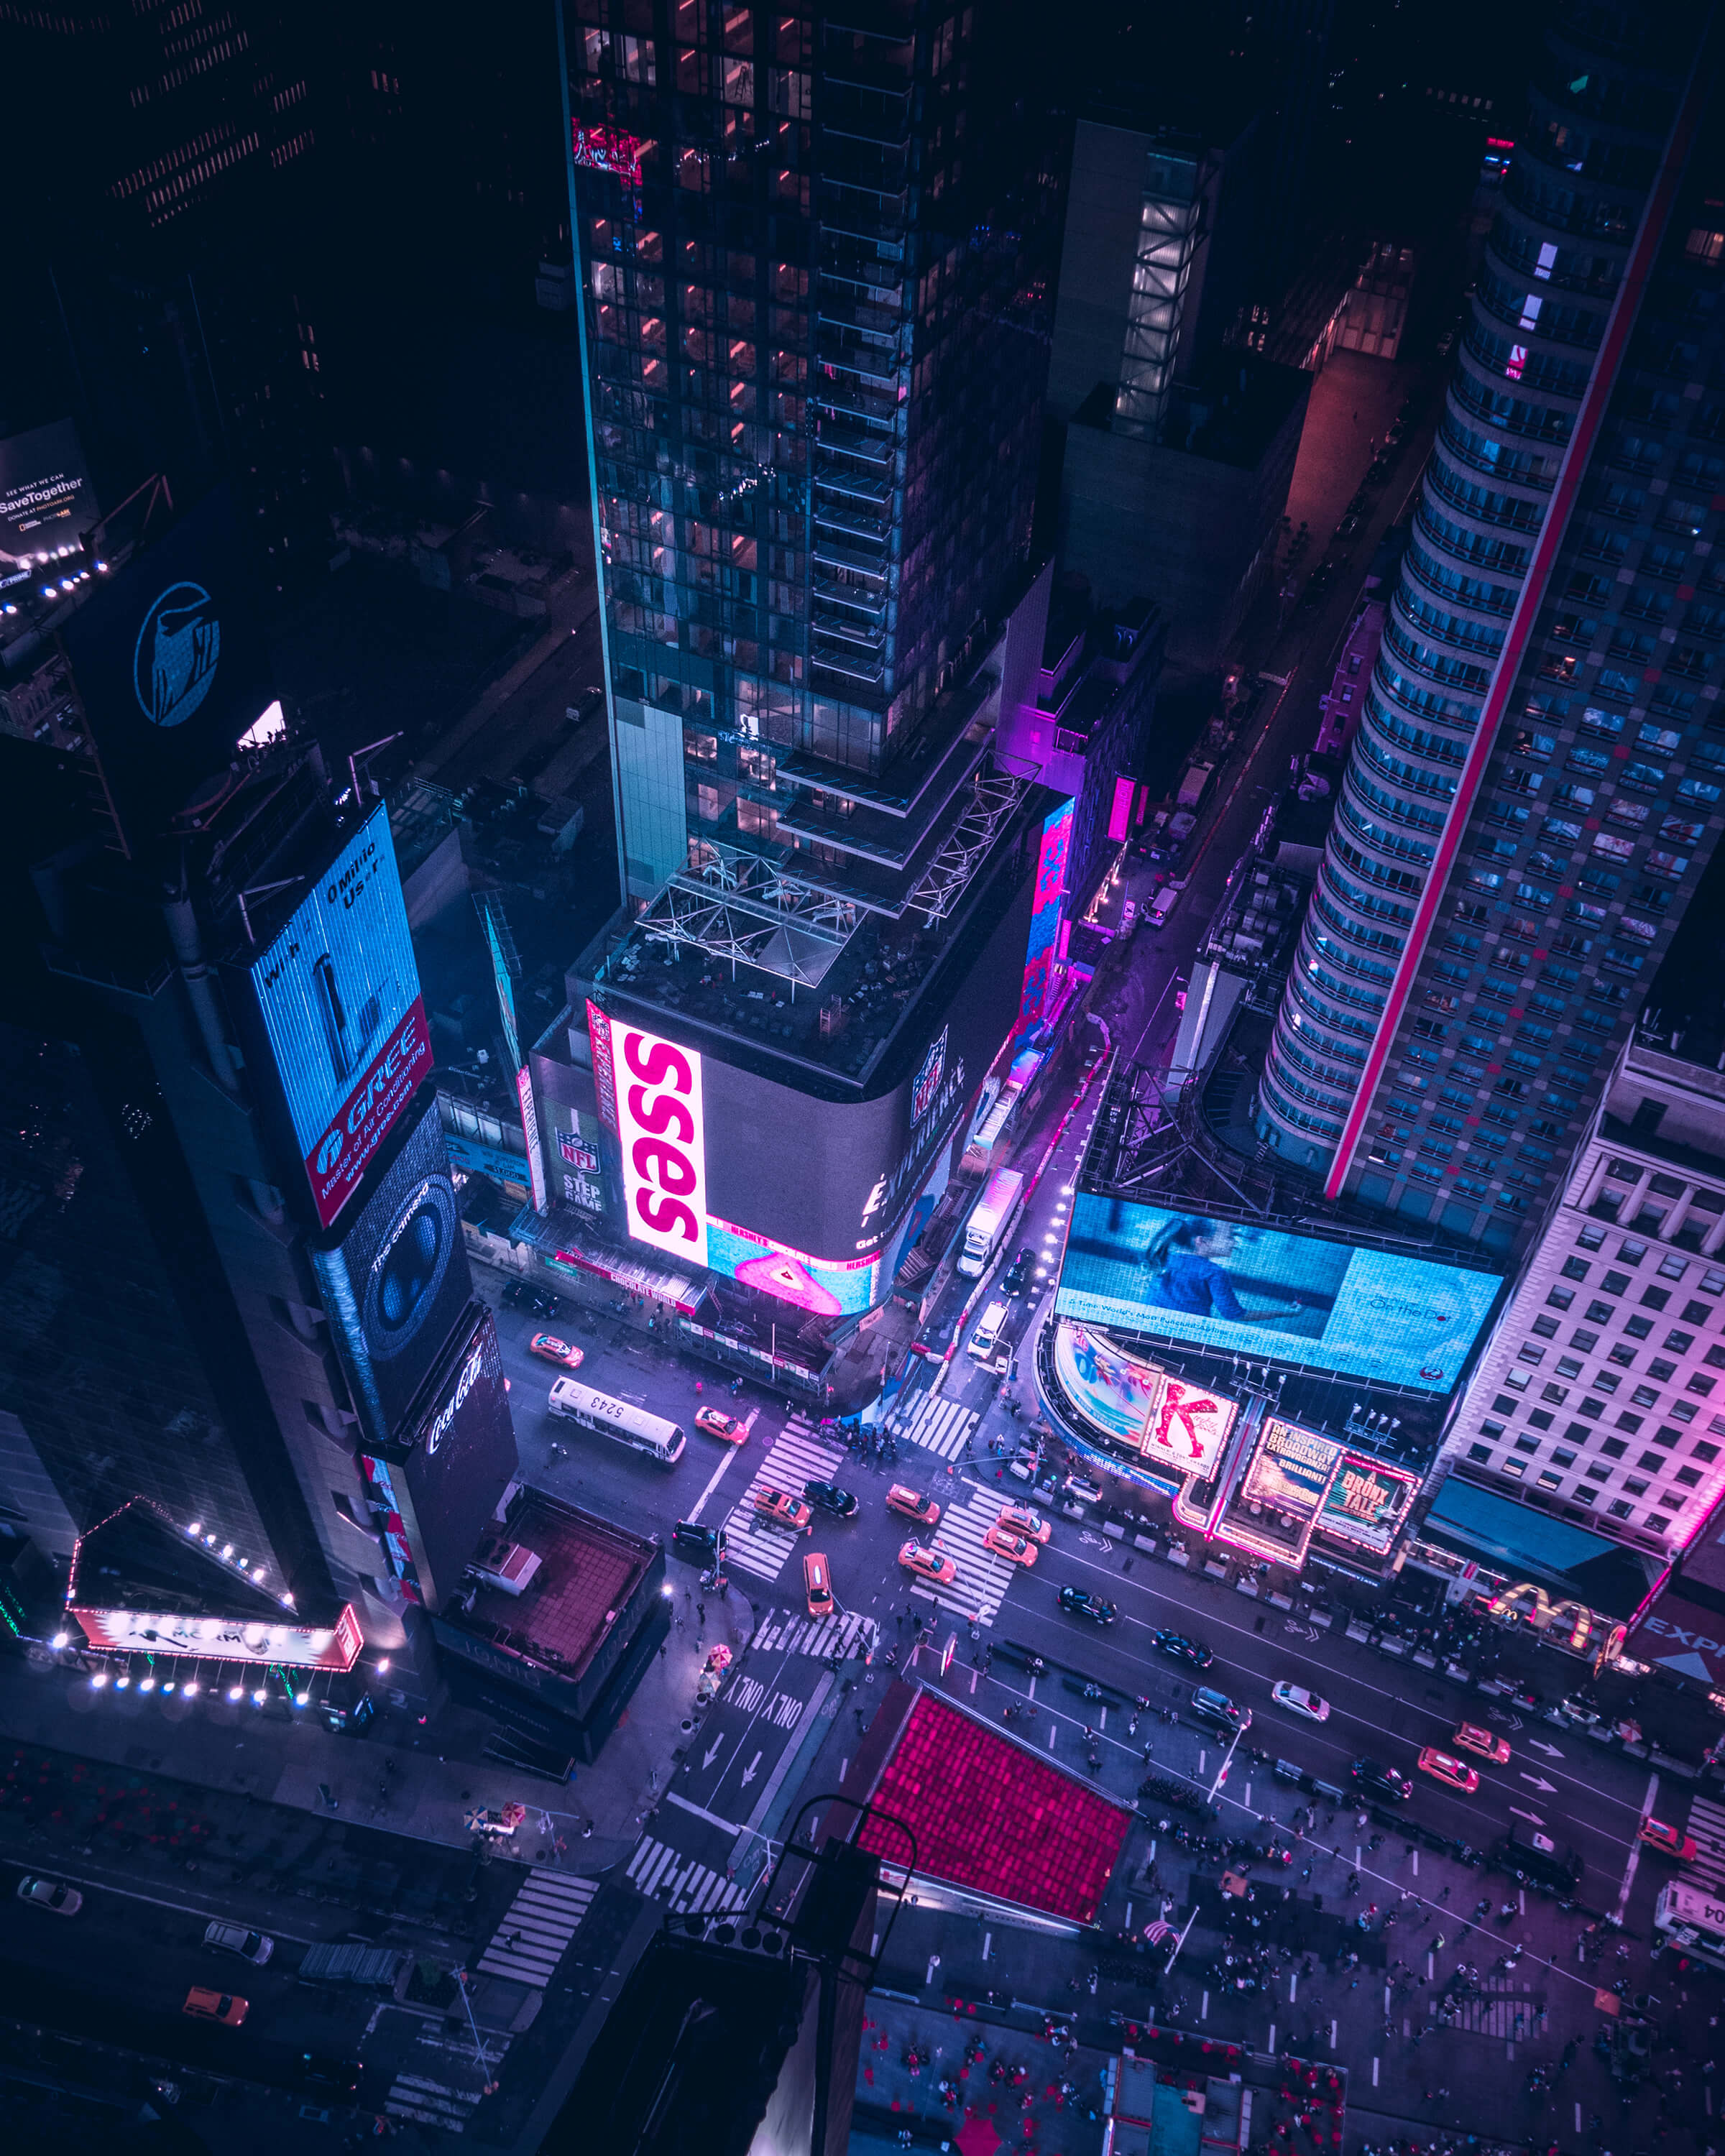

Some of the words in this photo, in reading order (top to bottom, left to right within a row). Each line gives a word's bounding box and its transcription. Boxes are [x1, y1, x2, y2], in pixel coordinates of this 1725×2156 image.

[19, 482, 37, 492] WHAT
[50, 473, 64, 482] CAN
[7, 510, 29, 522] DONATE
[347, 1016, 415, 1134] GREE
[322, 1151, 351, 1199] Master
[353, 1136, 362, 1152] of
[364, 1118, 374, 1138] Air
[376, 1041, 426, 1116] Conditioning
[521, 1087, 539, 1154] EXPERIENCE
[562, 1143, 597, 1170] NFL
[563, 1174, 601, 1197] STEP
[610, 1273, 650, 1298] CHOCOLATE
[651, 1290, 676, 1308] WORLD
[1101, 1304, 1133, 1317] World's
[1370, 1298, 1393, 1311] On
[1397, 1302, 1421, 1317] the
[591, 1396, 625, 1419] 5243
[1269, 1434, 1334, 1465] BROADWAY
[1272, 1424, 1289, 1437] AN
[1289, 1430, 1338, 1457] INSPIRED
[1266, 1442, 1331, 1473] EXTRAVAGANZA!
[1279, 1458, 1328, 1485] BRILLIANT!
[1341, 1470, 1389, 1506] BRONX
[1367, 1471, 1377, 1484] A
[1343, 1490, 1380, 1516] TALE
[722, 1674, 764, 1713] ONLY
[761, 1691, 803, 1730] ONLY
